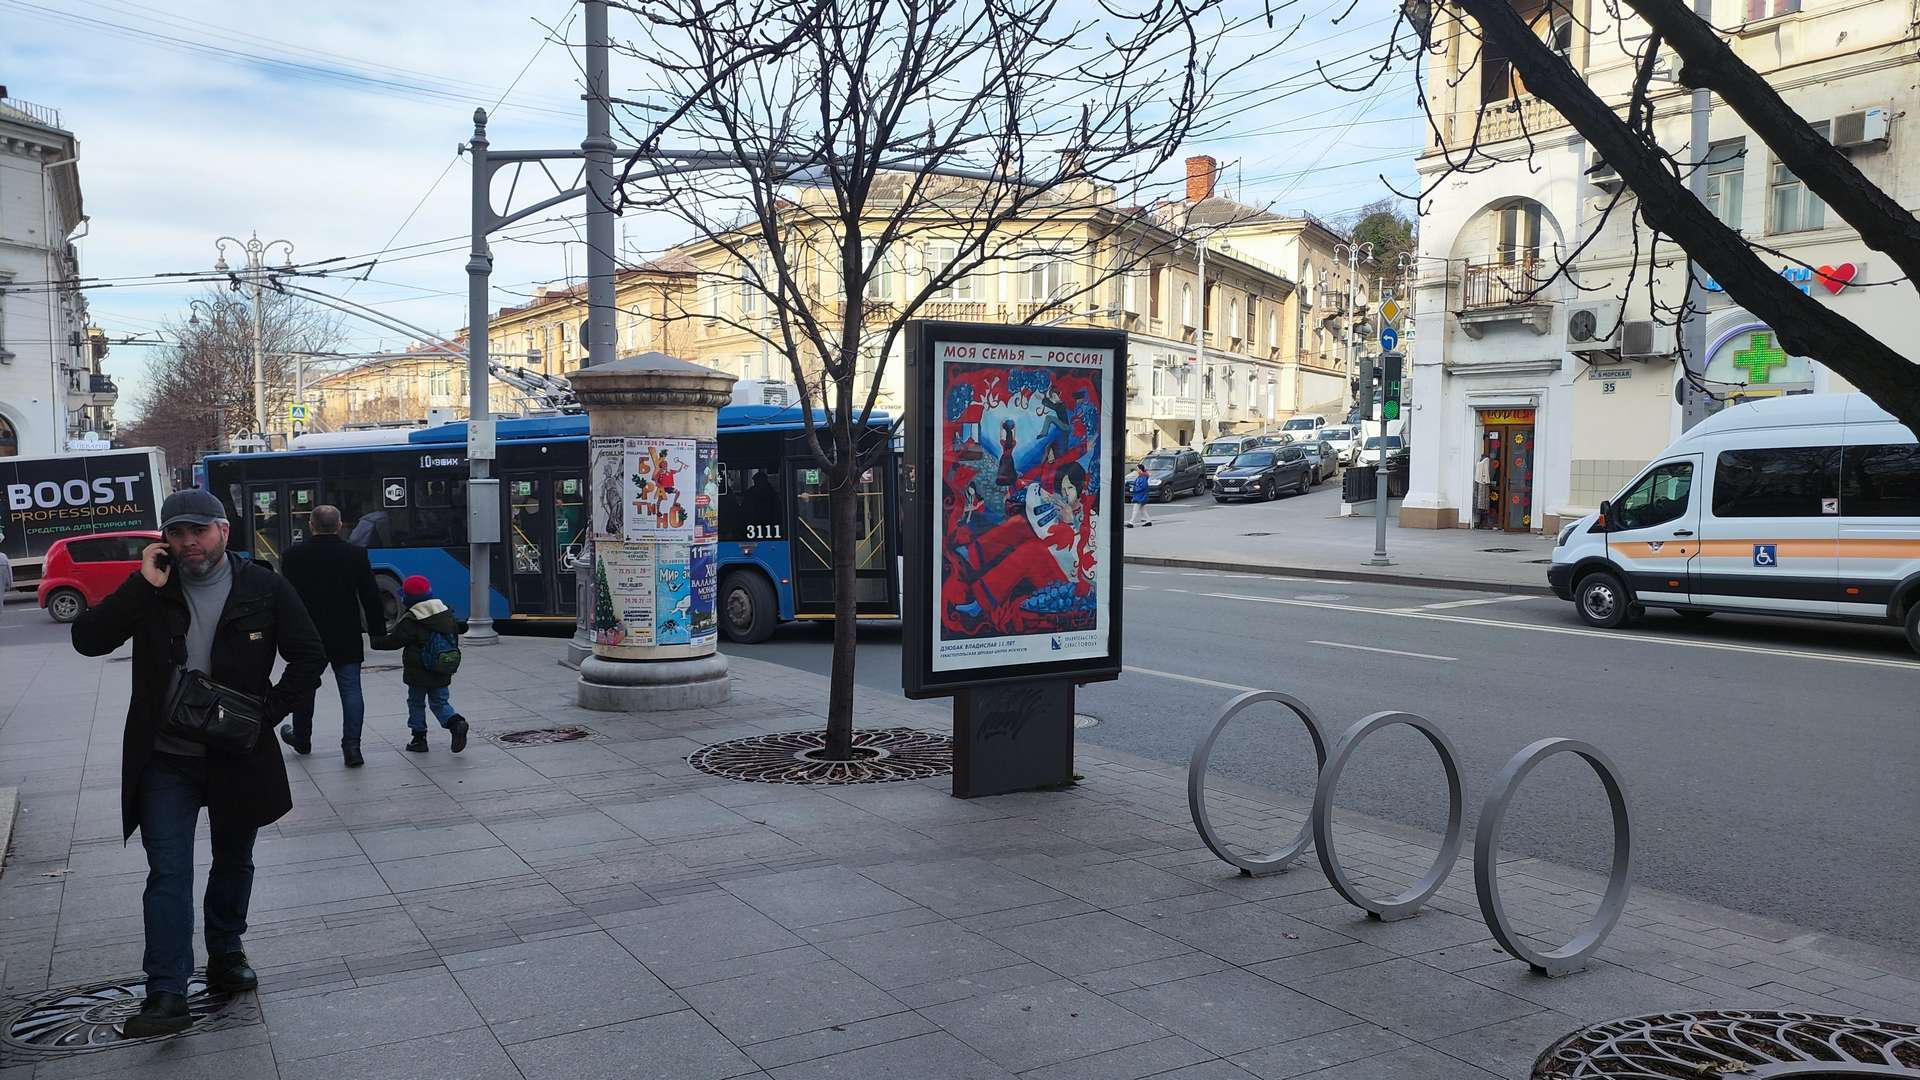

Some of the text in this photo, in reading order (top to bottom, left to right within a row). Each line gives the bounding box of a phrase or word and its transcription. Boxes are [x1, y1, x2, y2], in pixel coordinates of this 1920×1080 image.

[944, 346, 976, 359] МОЯ
[982, 348, 1025, 361] СЕМЬЯ
[1048, 351, 1103, 365] РОССИЯ!
[1604, 382, 1616, 392] 35
[7, 475, 140, 511] BOOST
[11, 503, 145, 522] PROFESSIONAL
[27, 525, 71, 535] СРЕДСТВА
[72, 523, 93, 531] ДЛЯ
[93, 520, 127, 529] СТИРКИ
[746, 524, 782, 539] 3111
[660, 569, 679, 582] МИР
[965, 641, 998, 650] ВЛАДИСЛАВ
